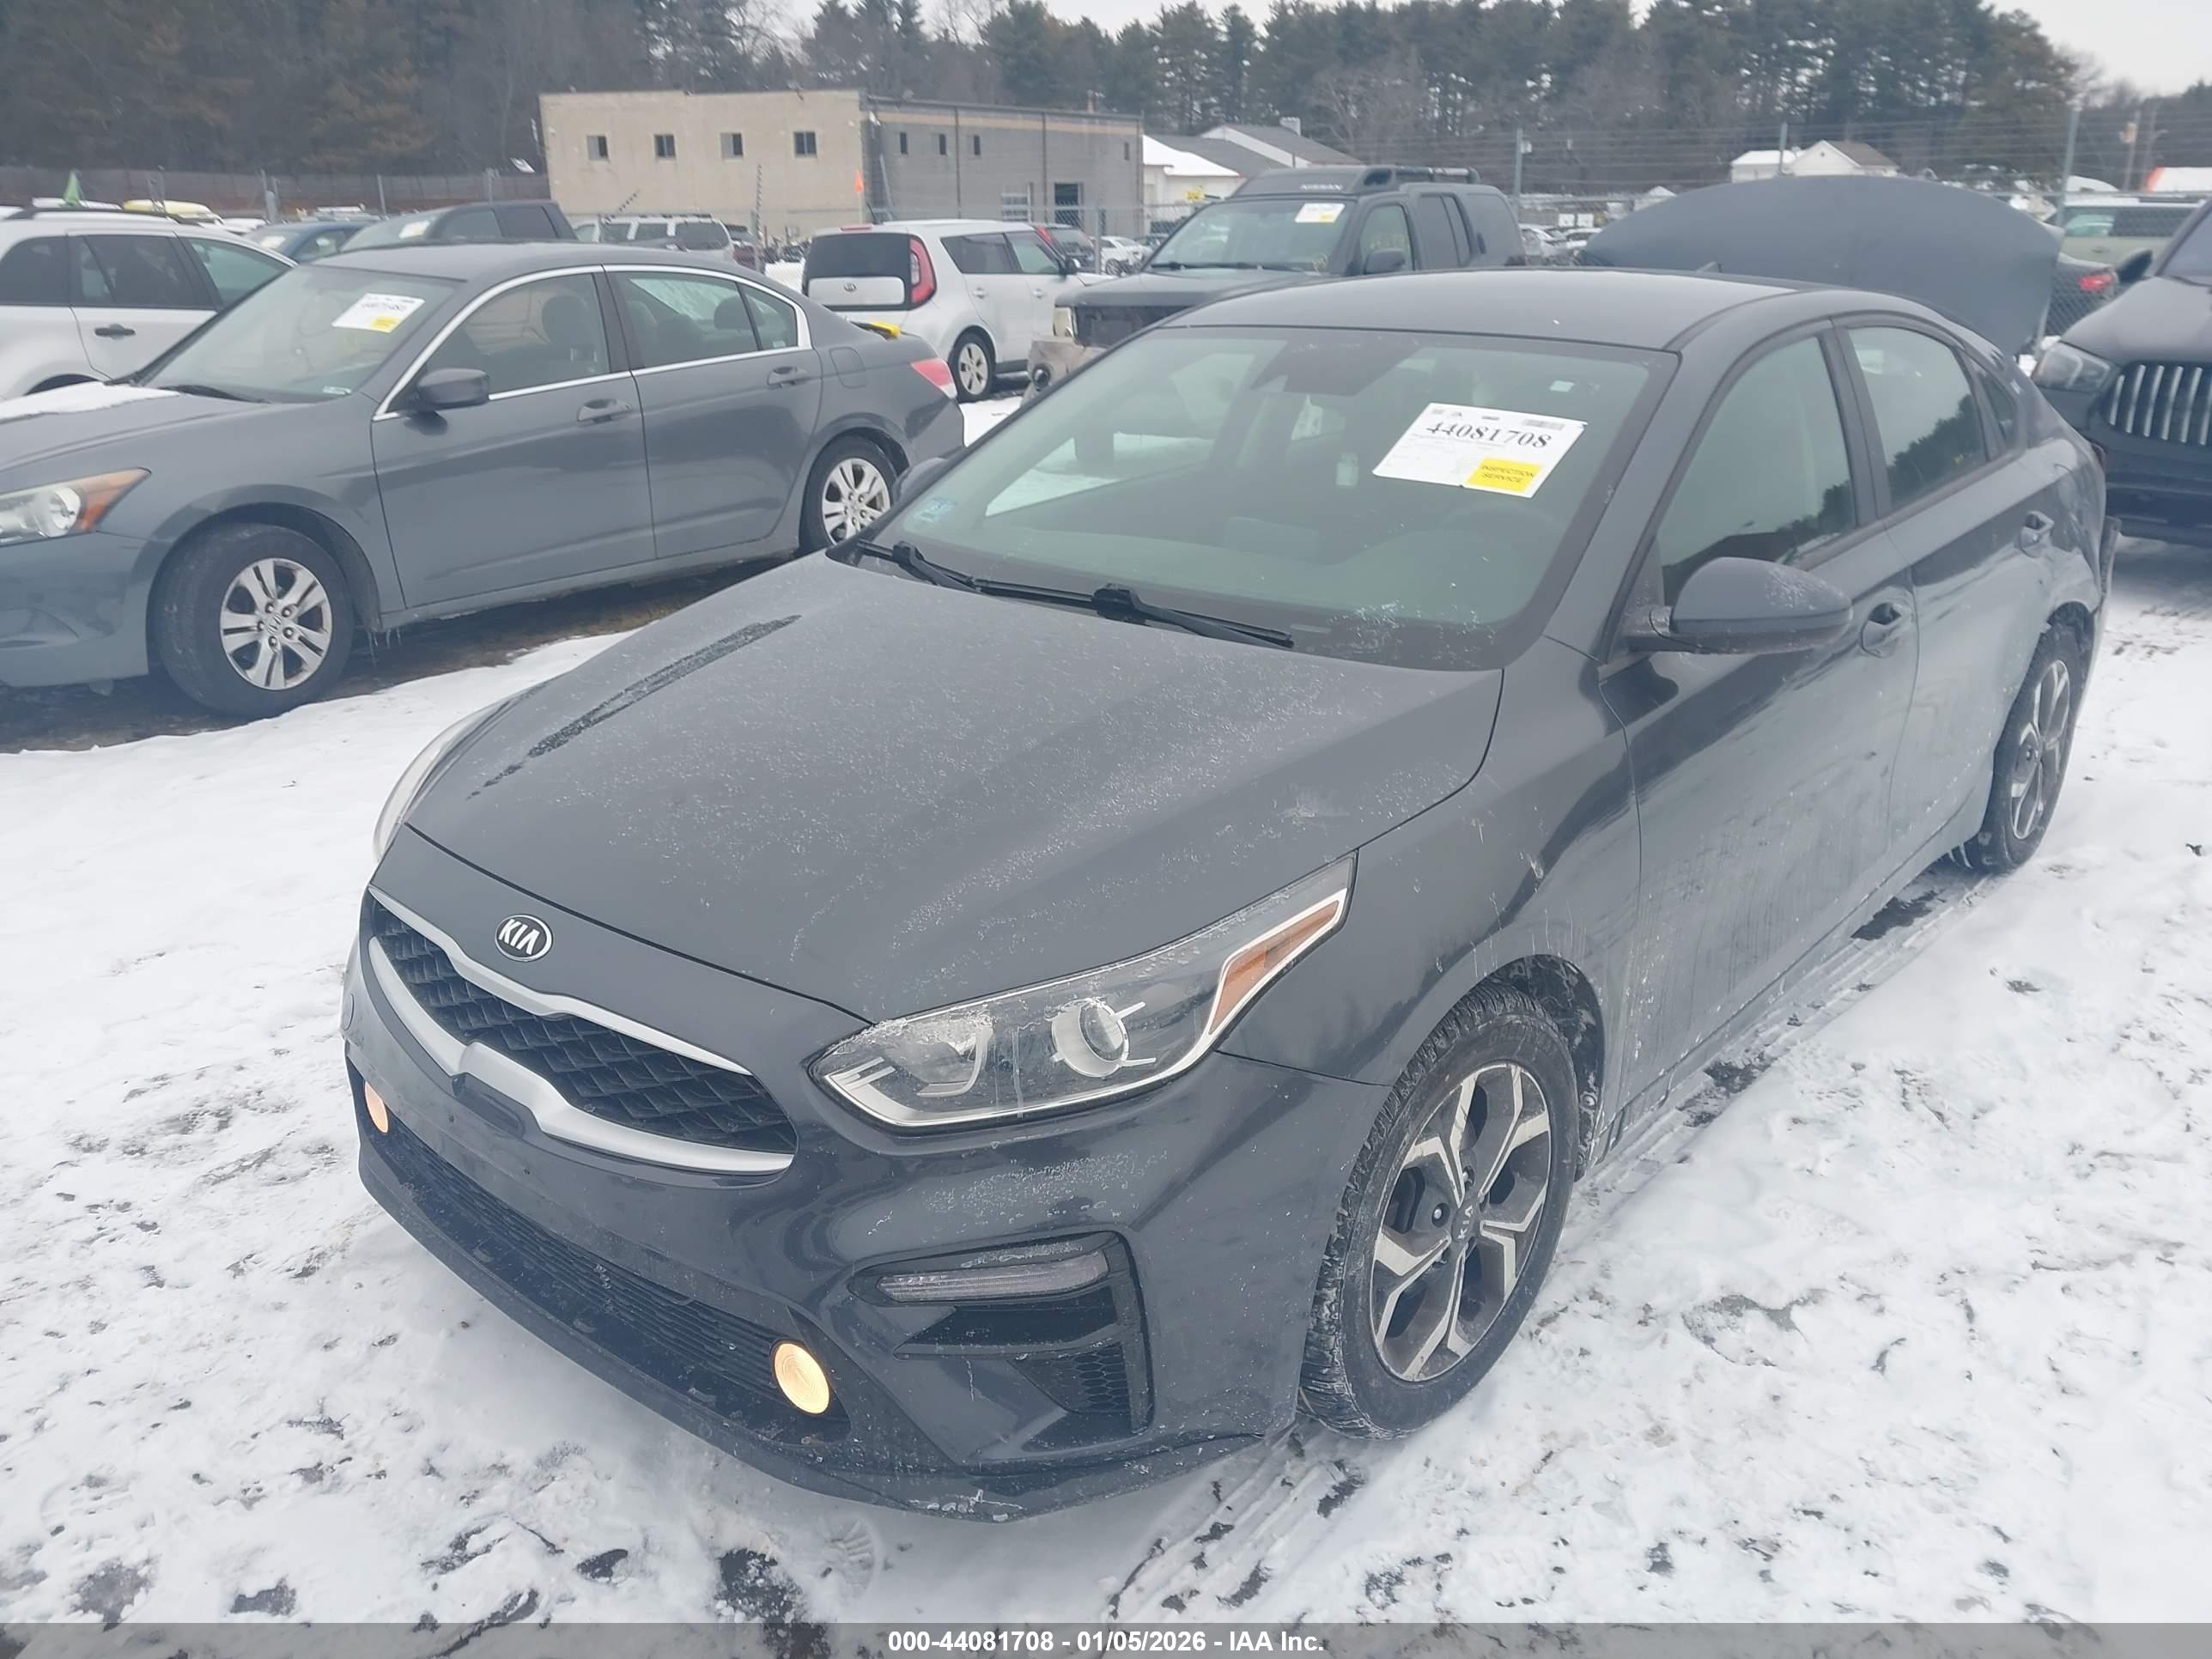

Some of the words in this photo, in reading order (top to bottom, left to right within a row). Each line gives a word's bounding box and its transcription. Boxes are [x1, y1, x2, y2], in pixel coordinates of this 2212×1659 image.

[1425, 421, 1553, 449] 44081708
[498, 918, 540, 956] KIA
[1457, 1205, 1474, 1239] KIA
